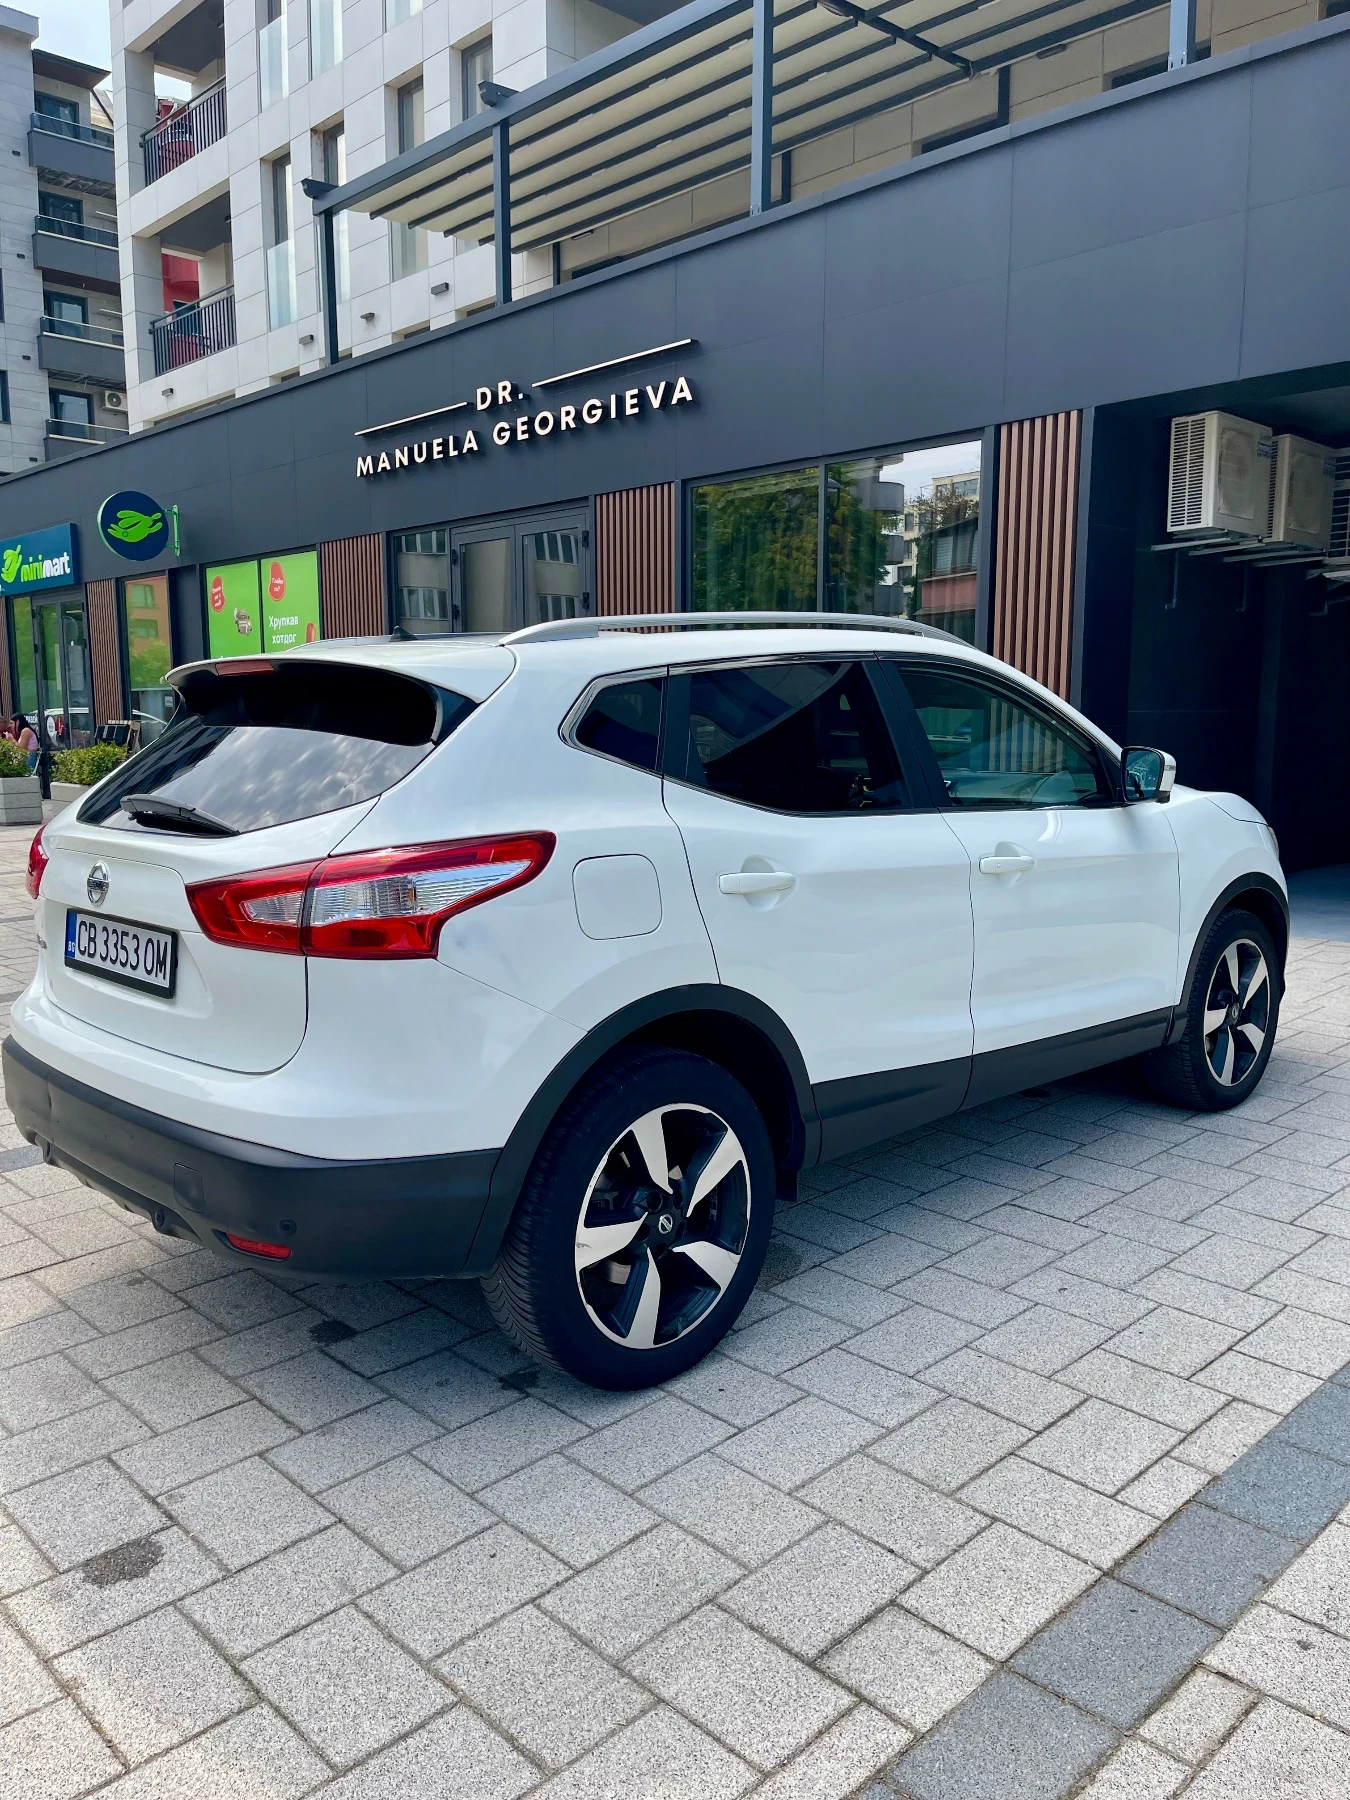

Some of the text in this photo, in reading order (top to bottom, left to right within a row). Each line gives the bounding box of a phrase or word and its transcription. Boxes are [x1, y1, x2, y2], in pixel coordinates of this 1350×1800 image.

[476, 380, 524, 411] DR.
[356, 376, 693, 478] MANUELA GEORGIEVA
[21, 552, 71, 582] minimart
[268, 615, 299, 630] Хрупкав
[272, 633, 297, 644] хотдог
[77, 920, 168, 980] CB 3353 OM
